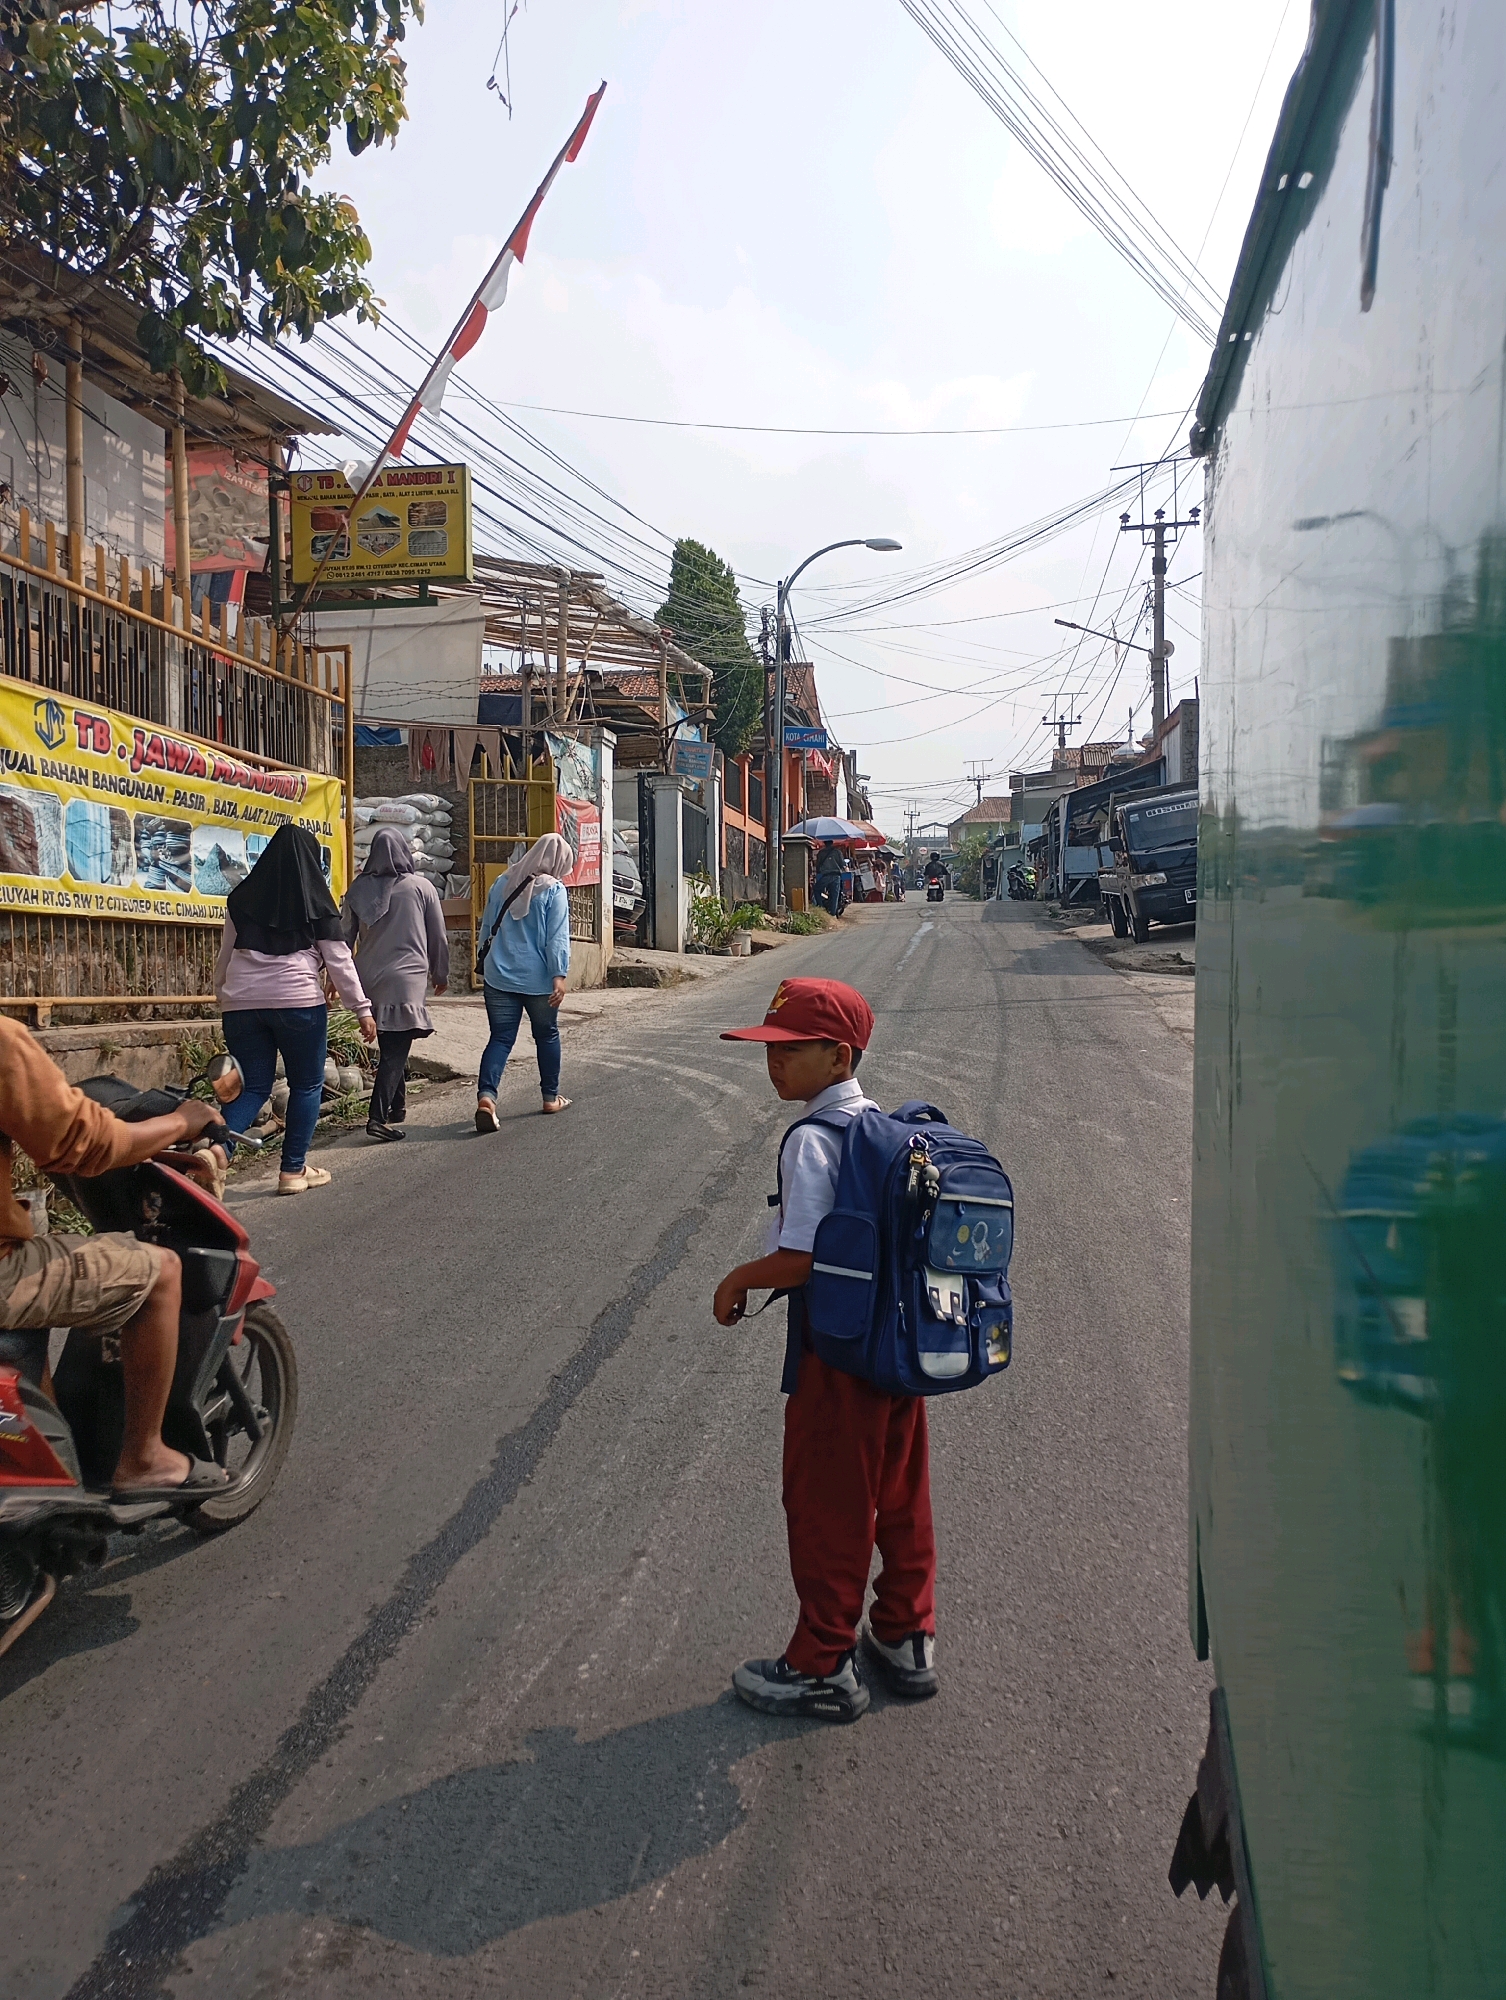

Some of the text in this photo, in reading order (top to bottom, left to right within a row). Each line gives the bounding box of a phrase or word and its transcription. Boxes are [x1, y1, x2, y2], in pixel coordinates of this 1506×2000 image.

[387, 471, 443, 486] MANDIRI
[447, 471, 455, 484] I
[785, 732, 825, 743] KOTA CIMAHI
[74, 710, 112, 754] TB
[130, 729, 207, 778] JAWA
[208, 753, 299, 800] MANDIRI
[40, 757, 89, 787] BAHAN
[93, 770, 165, 803] BANGUNAN
[172, 789, 205, 812] PASIR
[240, 804, 262, 822] ALAT
[299, 817, 321, 834] BAJA
[42, 889, 71, 908] RT.05
[74, 892, 92, 909] RW
[95, 894, 104, 910] 12
[153, 900, 175, 916] KEC.
[176, 902, 207, 918] CIMAHI
[814, 1703, 841, 1712] FASHION
